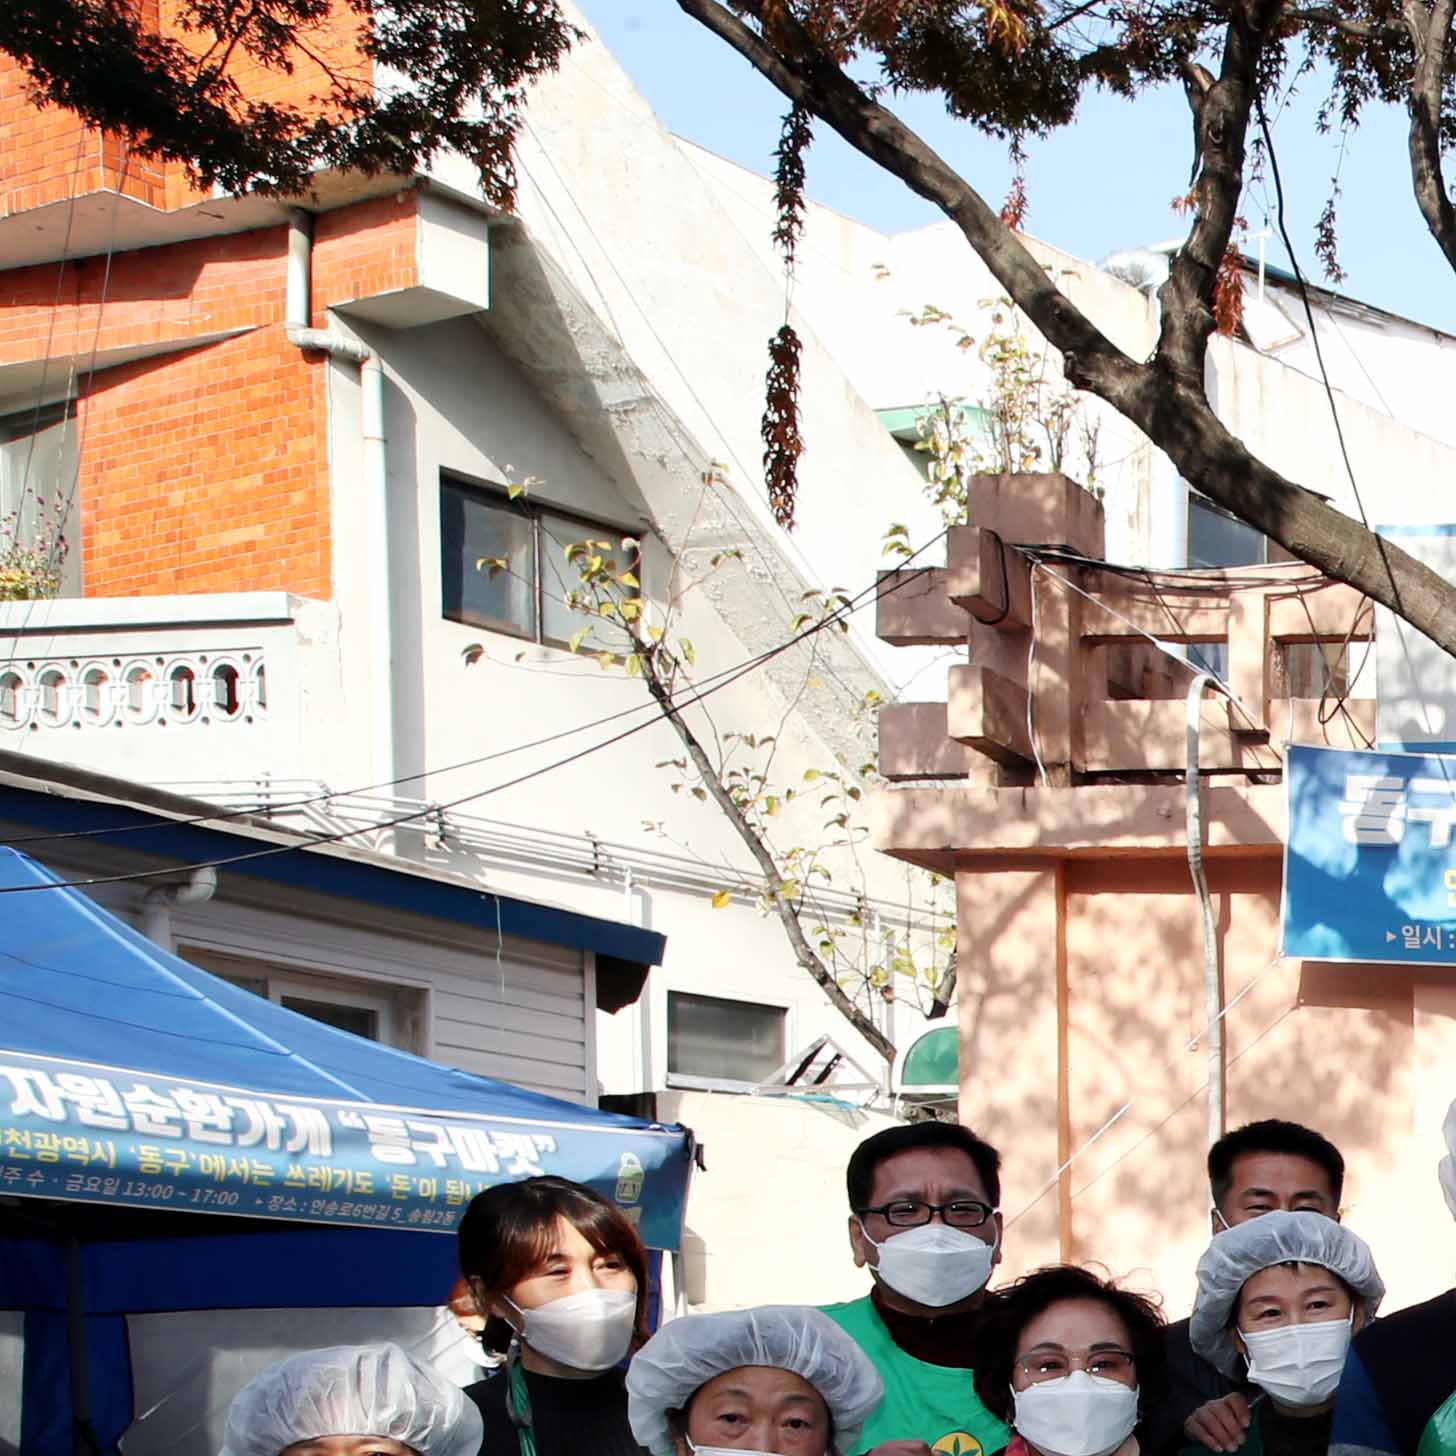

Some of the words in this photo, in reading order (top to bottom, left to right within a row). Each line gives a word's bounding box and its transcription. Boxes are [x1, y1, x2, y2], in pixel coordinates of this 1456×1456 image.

[1400, 925, 1443, 951] 일시
[0, 1065, 333, 1158] 자원순환가게
[0, 1127, 117, 1169] 천광역시
[283, 1163, 375, 1195] 쓰레기도
[65, 1173, 121, 1197] 금요일
[123, 1180, 174, 1200] 13:00
[192, 1188, 240, 1206] 17:00
[267, 1194, 297, 1212] 장소
